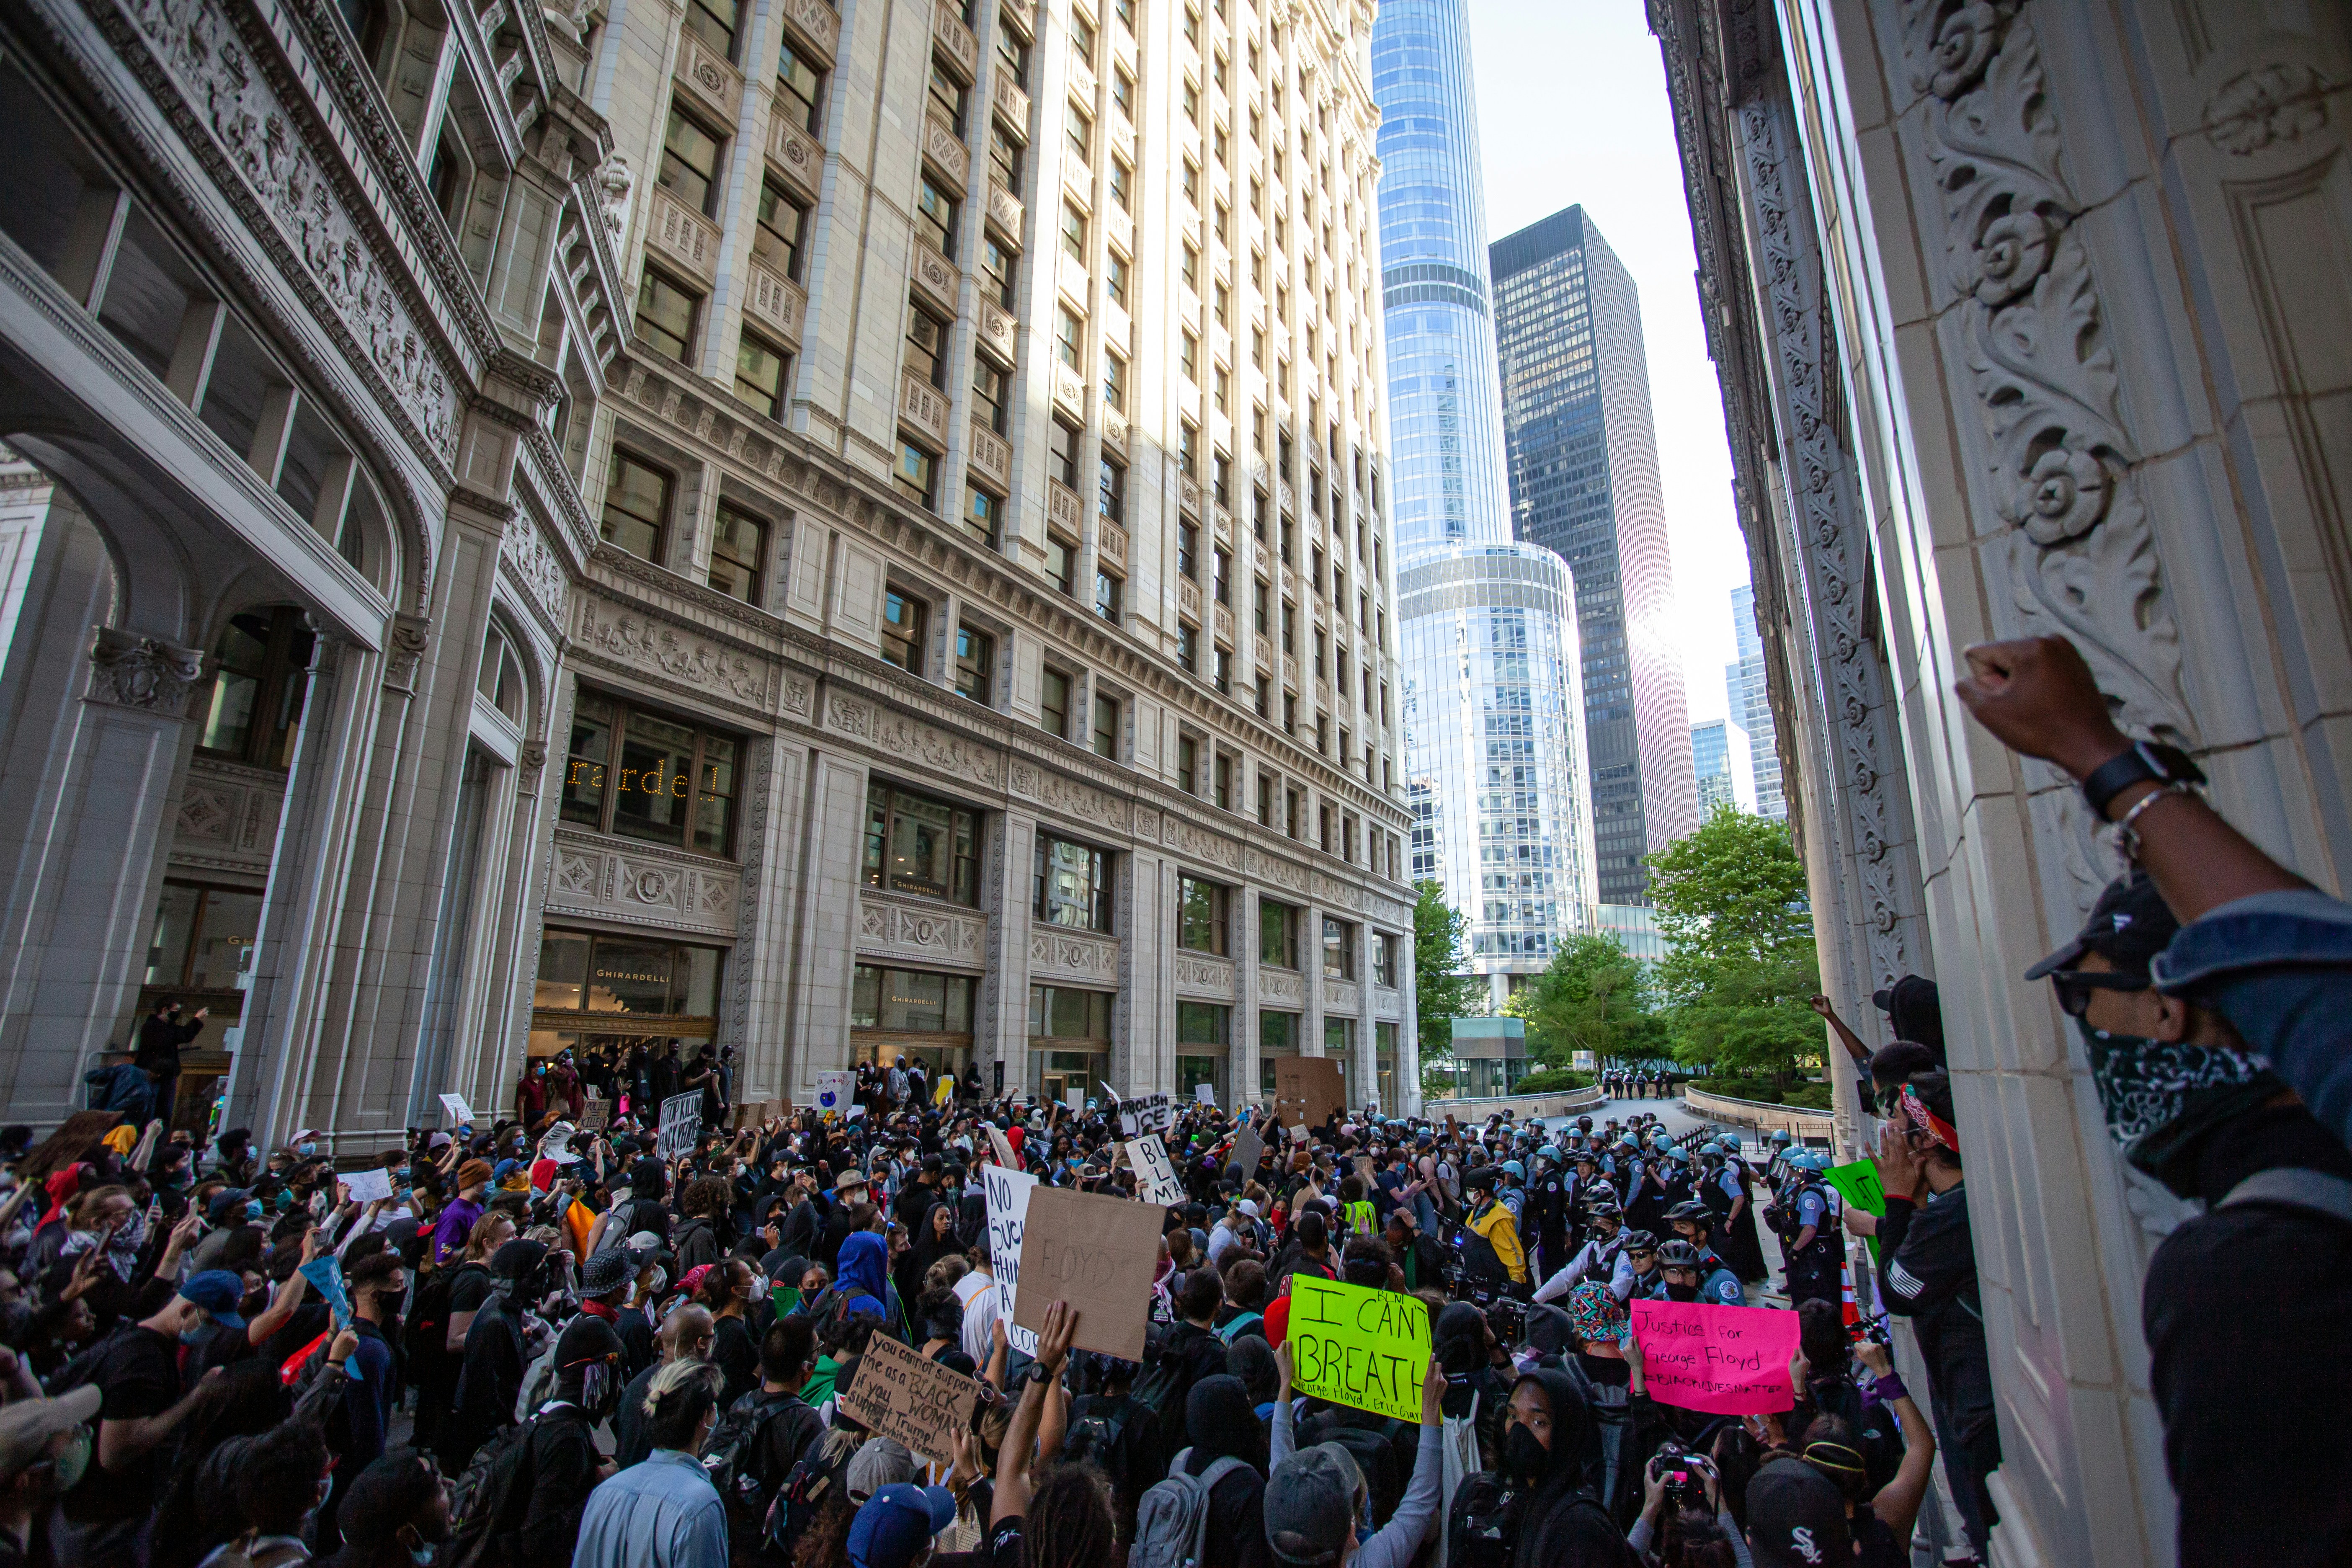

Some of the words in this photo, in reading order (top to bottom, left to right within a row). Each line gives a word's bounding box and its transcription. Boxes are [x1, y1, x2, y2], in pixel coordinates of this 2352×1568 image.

[897, 882, 940, 895] GHIRARDELLI
[597, 970, 669, 983] GHIRARDELLI
[892, 996, 936, 1005] GHIRARDELLI
[586, 1101, 609, 1111] POLICE
[663, 1100, 679, 1127] STOP
[1120, 1095, 1168, 1115] ABOLISH
[1134, 1108, 1166, 1132] ICE
[988, 1173, 1011, 1213] NO
[1042, 1239, 1114, 1289] FLOYD
[1378, 1290, 1404, 1305] BLM
[1721, 1282, 1736, 1290] CHICAGO
[1357, 1299, 1430, 1349] CAN'T
[1643, 1343, 1695, 1370] George
[1705, 1346, 1760, 1370] Floyd
[864, 1354, 883, 1372] me
[885, 1366, 896, 1382] as
[899, 1373, 905, 1385] a
[899, 1348, 935, 1375] cannot
[936, 1368, 977, 1395] support
[856, 1372, 867, 1388] if
[868, 1381, 892, 1403] you
[1292, 1376, 1329, 1397] George
[1374, 1398, 1397, 1414] Eric
[882, 1424, 908, 1444] white
[896, 1411, 937, 1444] Trump!
[705, 1453, 723, 1463] NIKE
